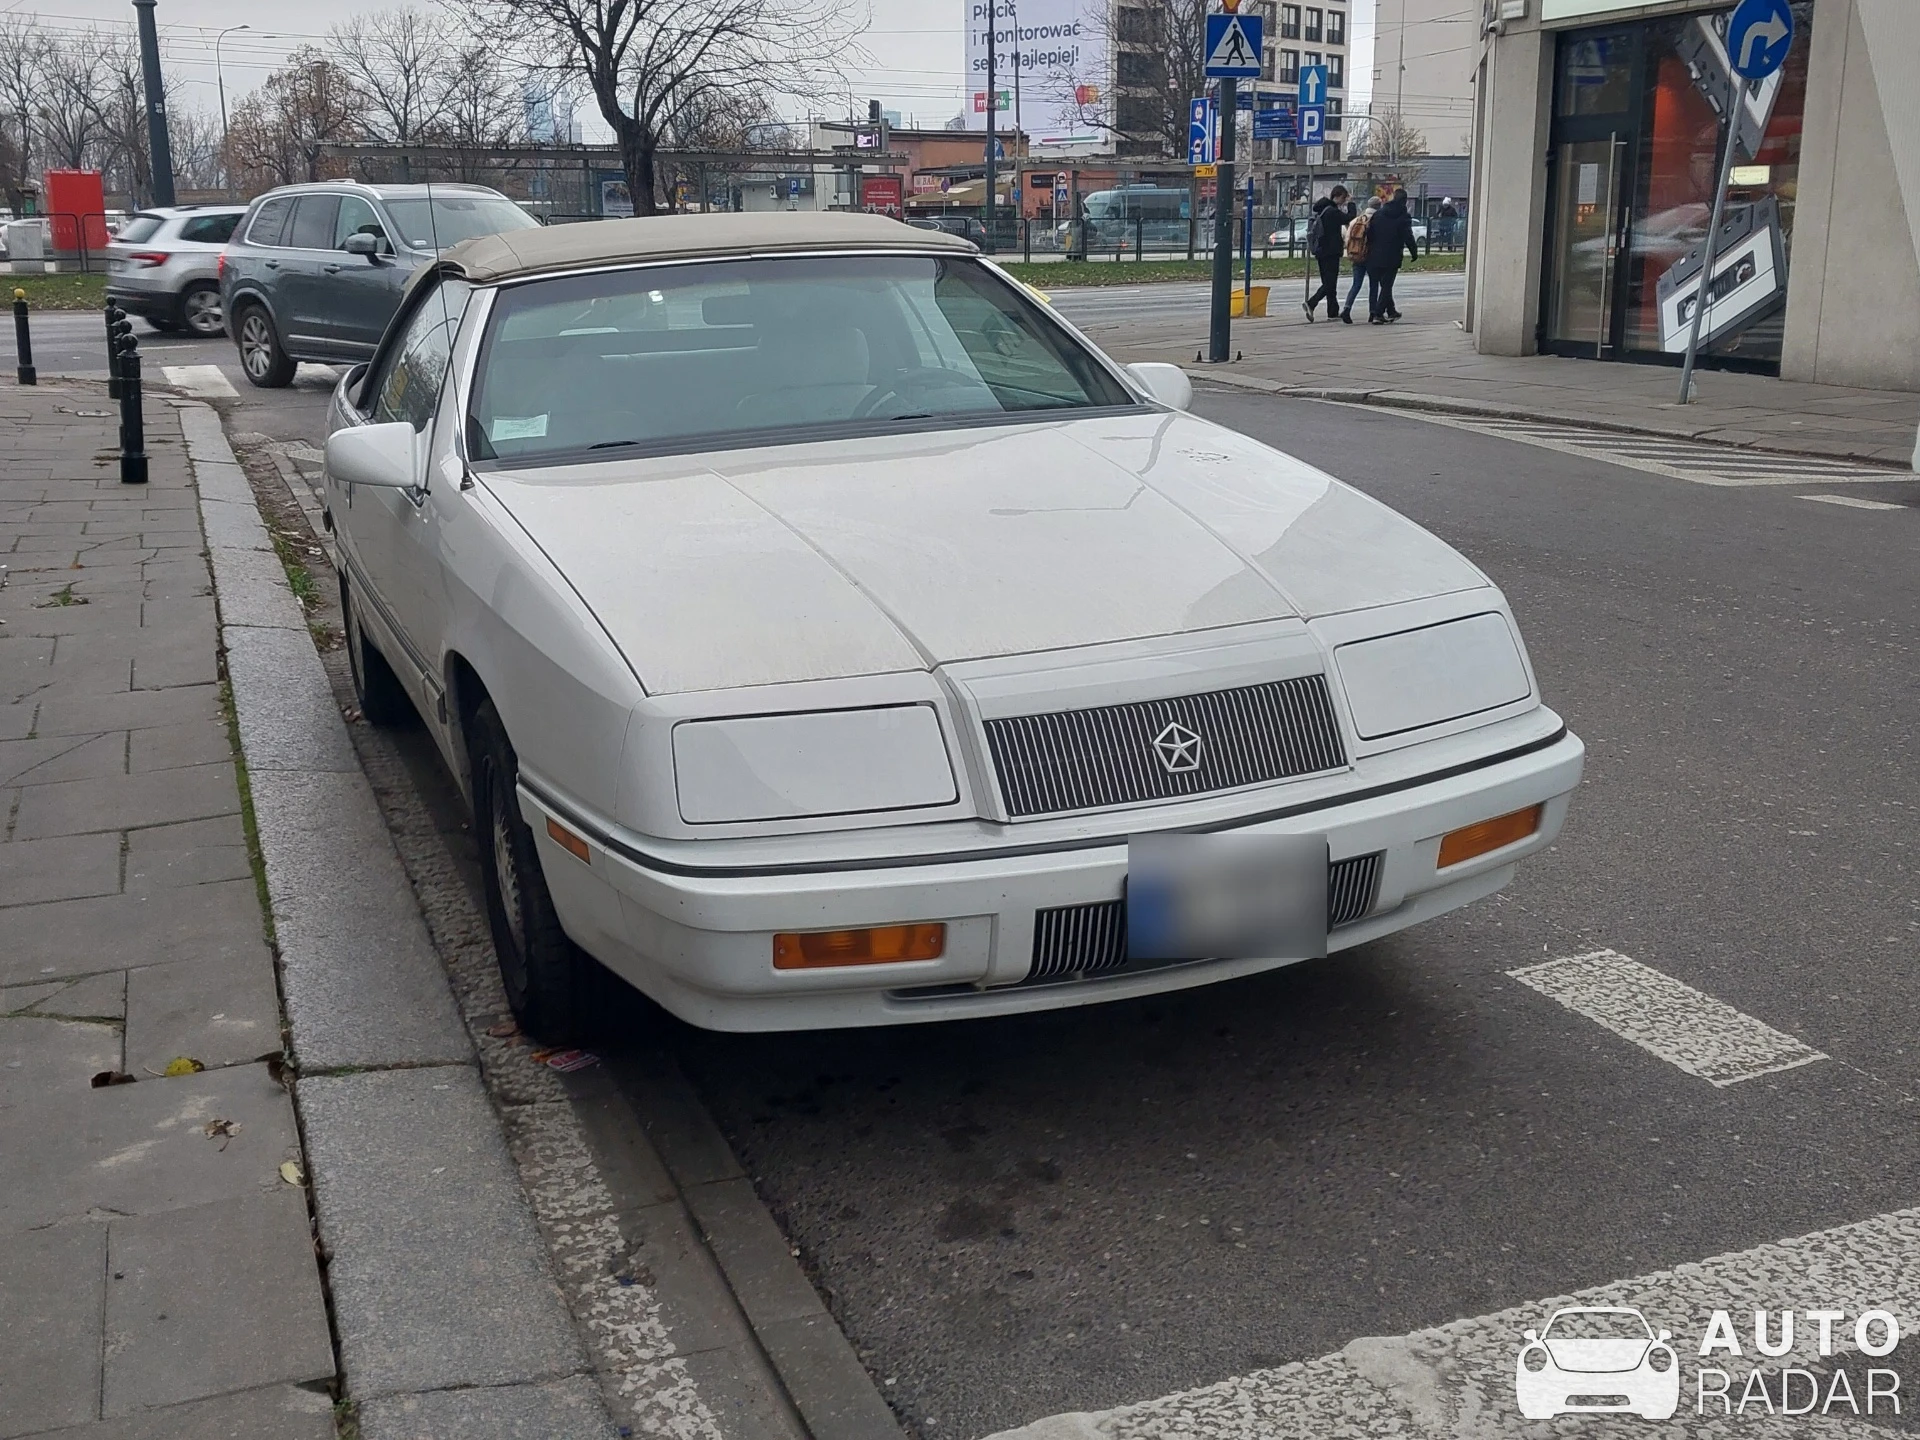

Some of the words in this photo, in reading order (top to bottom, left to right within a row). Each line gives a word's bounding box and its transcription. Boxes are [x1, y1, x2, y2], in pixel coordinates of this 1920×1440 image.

[973, 29, 976, 46] i
[981, 18, 1081, 45] montorować
[1010, 44, 1079, 70] Najlepiej!
[977, 96, 1007, 108] mnk
[1303, 110, 1319, 141] P
